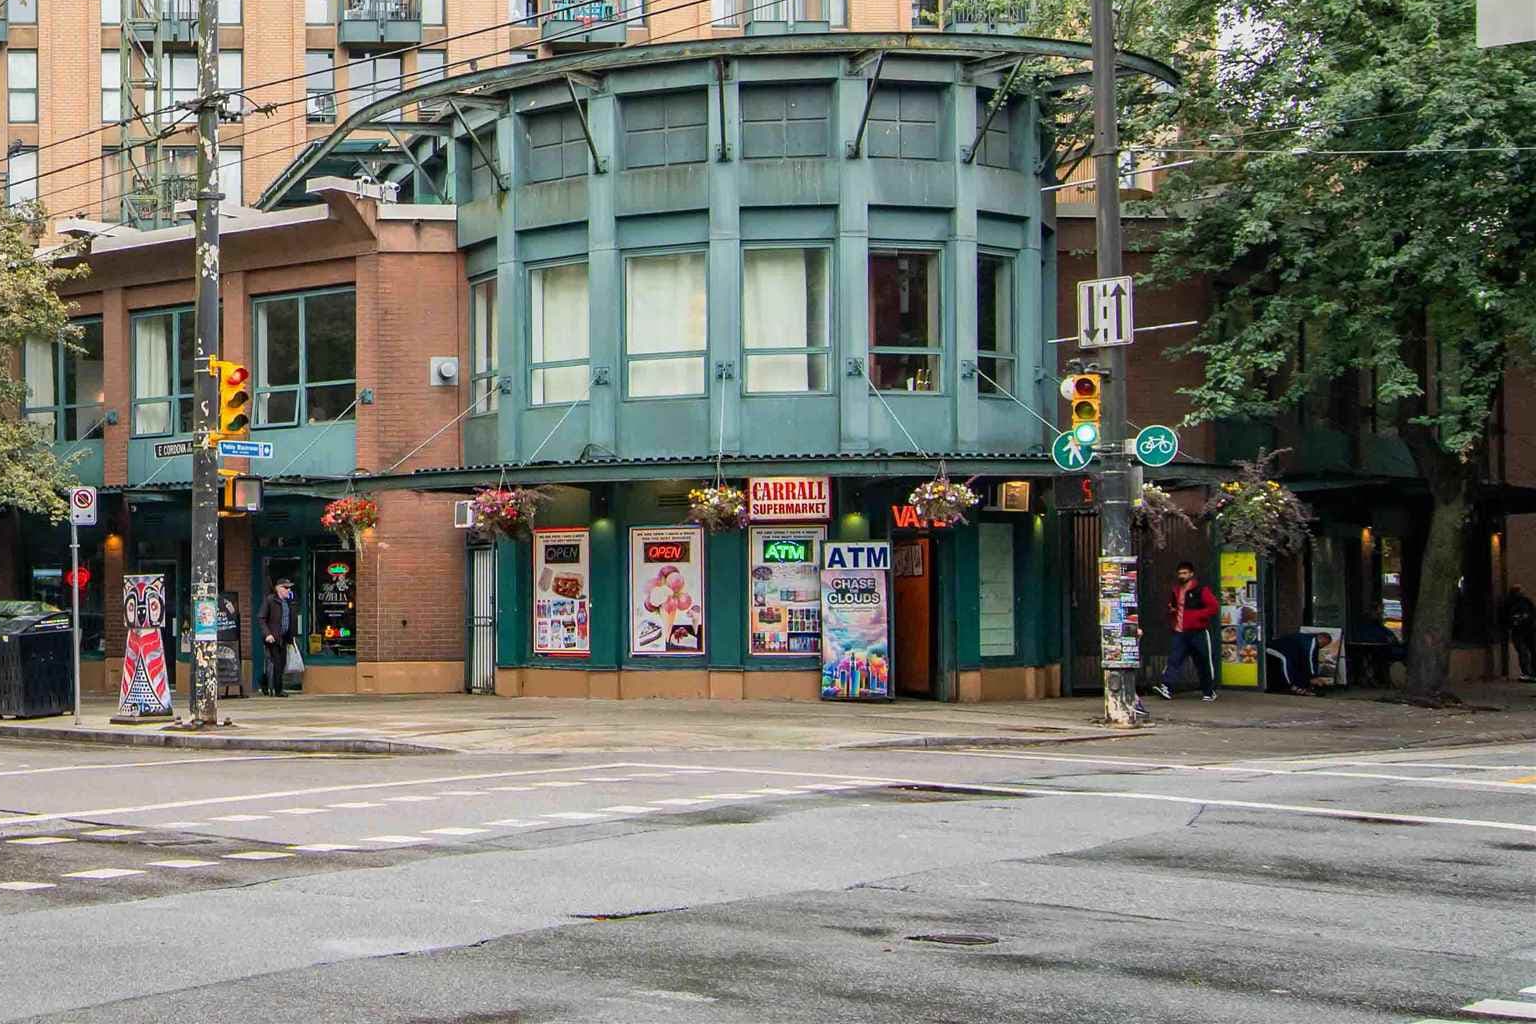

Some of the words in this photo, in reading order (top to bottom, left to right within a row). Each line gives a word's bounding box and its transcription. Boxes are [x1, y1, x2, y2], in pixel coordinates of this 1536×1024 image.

[752, 481, 826, 501] CARRALL
[752, 503, 827, 515] SUPERMARKET
[892, 505, 947, 528] VA
[546, 546, 578, 561] OPEN
[648, 546, 681, 559] OPEN
[765, 544, 805, 560] ATM
[827, 547, 888, 568] ATM
[832, 578, 875, 590] CHASE
[828, 592, 880, 604] CLOUDS
